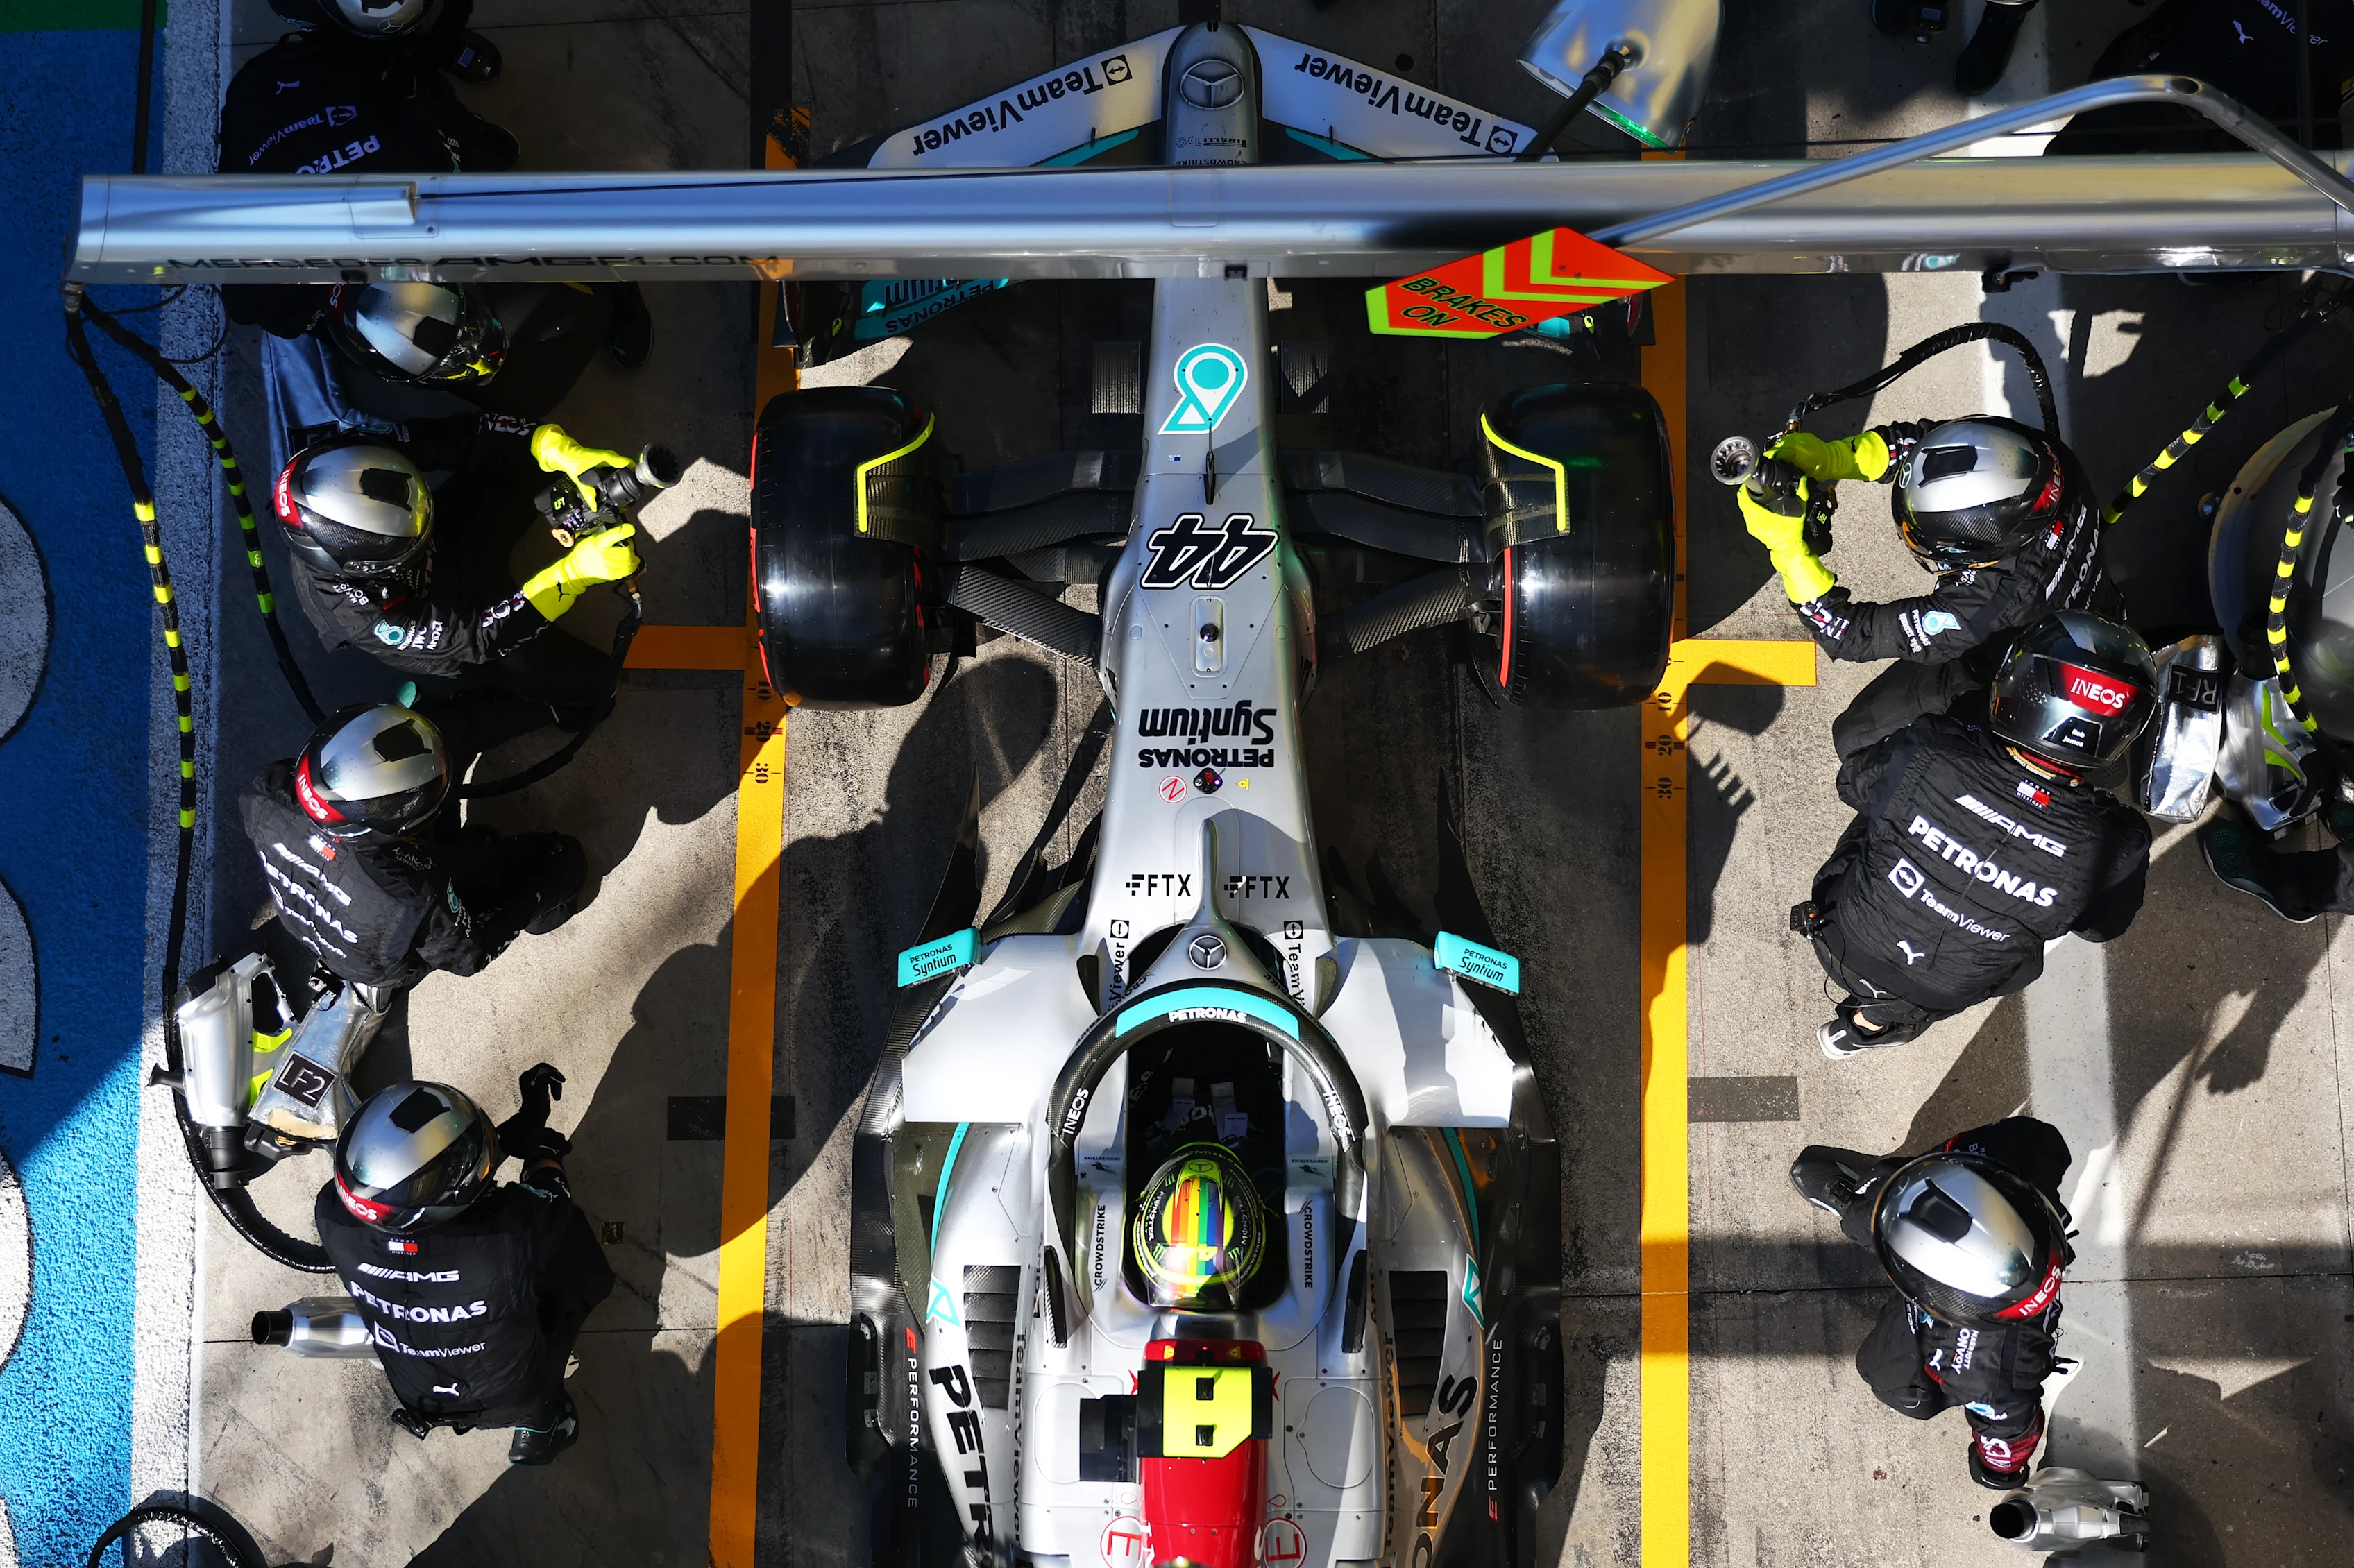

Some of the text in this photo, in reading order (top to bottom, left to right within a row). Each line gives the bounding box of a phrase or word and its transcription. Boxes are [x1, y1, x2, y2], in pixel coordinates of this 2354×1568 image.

[2258, 0, 2328, 46] amVieer
[913, 67, 1104, 156] TeamViewer
[1296, 53, 1482, 148] TeamViewer
[249, 114, 324, 166] TeamViewer
[289, 135, 382, 174] PETRO
[885, 281, 996, 334] PETRONAS
[1399, 277, 1529, 328] BRAKES
[1400, 306, 1462, 327] ON
[278, 469, 291, 518] INEOS
[1816, 510, 1828, 525] RF1
[1140, 513, 1280, 590] 44
[1912, 609, 1931, 647] PETRONAS
[758, 681, 770, 700] 10
[1658, 692, 1671, 711] 10
[2070, 678, 2126, 709] INEOS
[2171, 671, 2218, 706] RF1
[756, 721, 770, 742] 20
[1138, 700, 1276, 745] Syntium
[2071, 728, 2085, 738] Rob
[1139, 748, 1274, 768] PETRONAS
[1658, 735, 1671, 756] 20
[756, 763, 769, 783] 30
[1658, 778, 1671, 799] 30
[2024, 779, 2051, 796] TOMMY
[298, 773, 329, 819] INEOS
[1986, 812, 2067, 858] AMG
[1908, 815, 2058, 907] PETRONAS
[1147, 874, 1191, 897] FTX
[1245, 876, 1290, 899] FTX
[1920, 889, 2010, 942] TeamViewer
[910, 944, 954, 964] PETRONAS
[913, 954, 957, 977] Syntium
[1289, 943, 1306, 1007] TeamVi
[1458, 957, 1505, 982] Syntium
[1464, 948, 1508, 970] PETRONAS
[1109, 948, 1125, 1003] Viewer
[1168, 1007, 1248, 1024] PETRONAS
[278, 1060, 325, 1102] LF2
[1062, 1088, 1090, 1135] INEOS
[1323, 1091, 1352, 1138] INEOS
[339, 1185, 378, 1220] INEOS
[1094, 1204, 1106, 1286] CROWDSTRIKE
[1303, 1206, 1313, 1288] CROWDSTRIKE
[389, 1270, 460, 1282] AMG
[2019, 1264, 2063, 1316] INEOS
[351, 1280, 488, 1323] PETRONAS
[399, 1342, 486, 1358] TeamViewer
[1951, 1327, 1971, 1374] ONVOY
[1963, 1329, 1979, 1370] MARRIOTT
[908, 1357, 918, 1508] PERFORMANCE
[1488, 1338, 1503, 1492] PERFORMANCE
[1013, 1327, 1026, 1547] TeamViewer
[929, 1365, 994, 1556] PETR
[1413, 1373, 1479, 1568] ONAS
